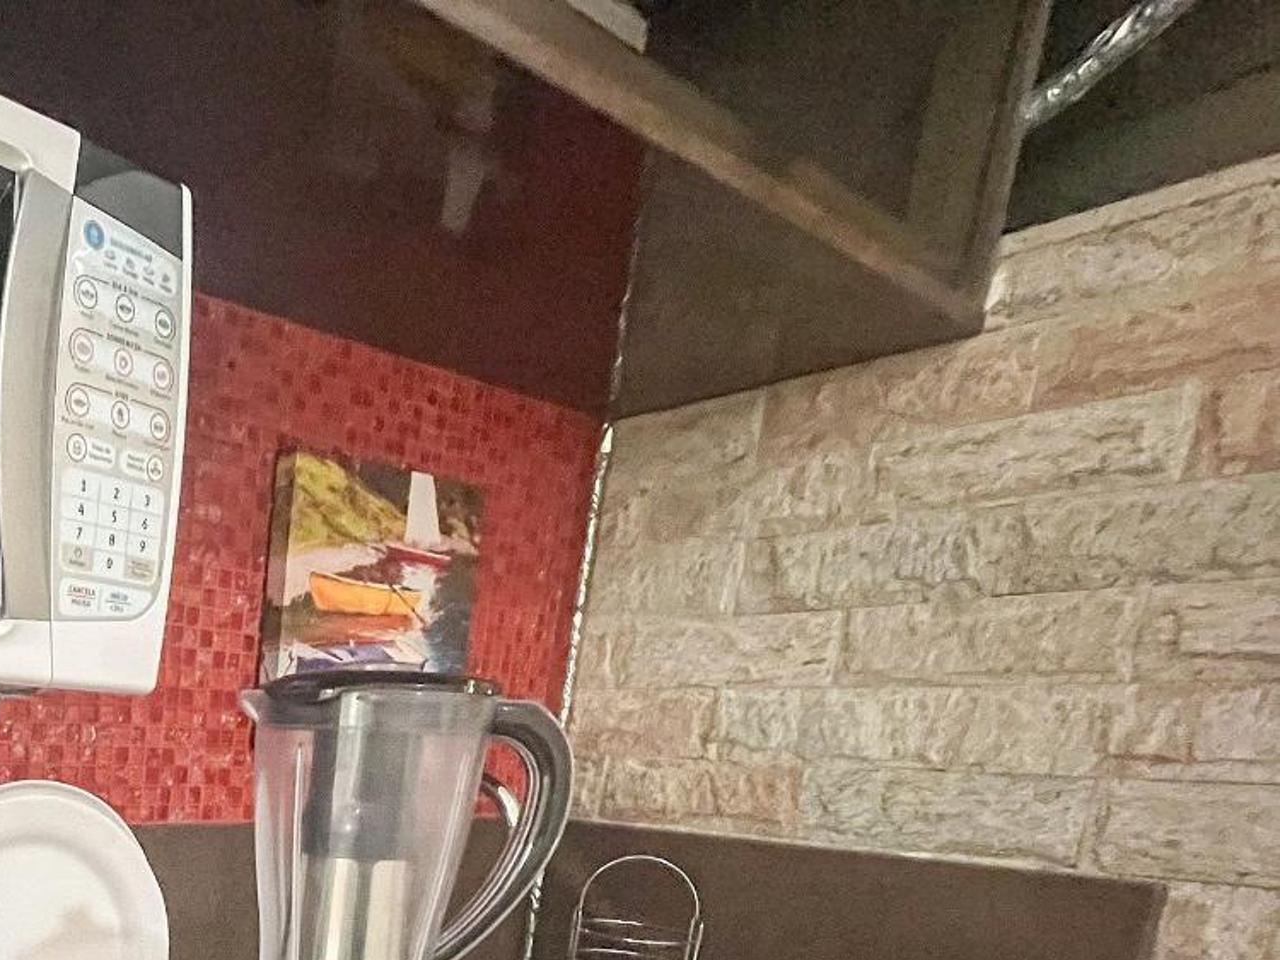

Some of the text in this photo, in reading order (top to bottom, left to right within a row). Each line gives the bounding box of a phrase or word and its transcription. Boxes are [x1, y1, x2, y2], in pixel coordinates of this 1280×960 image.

[113, 487, 120, 500] 2
[144, 494, 151, 507] 3
[78, 504, 148, 530] 4 5 6
[76, 526, 146, 552] 7 8 9
